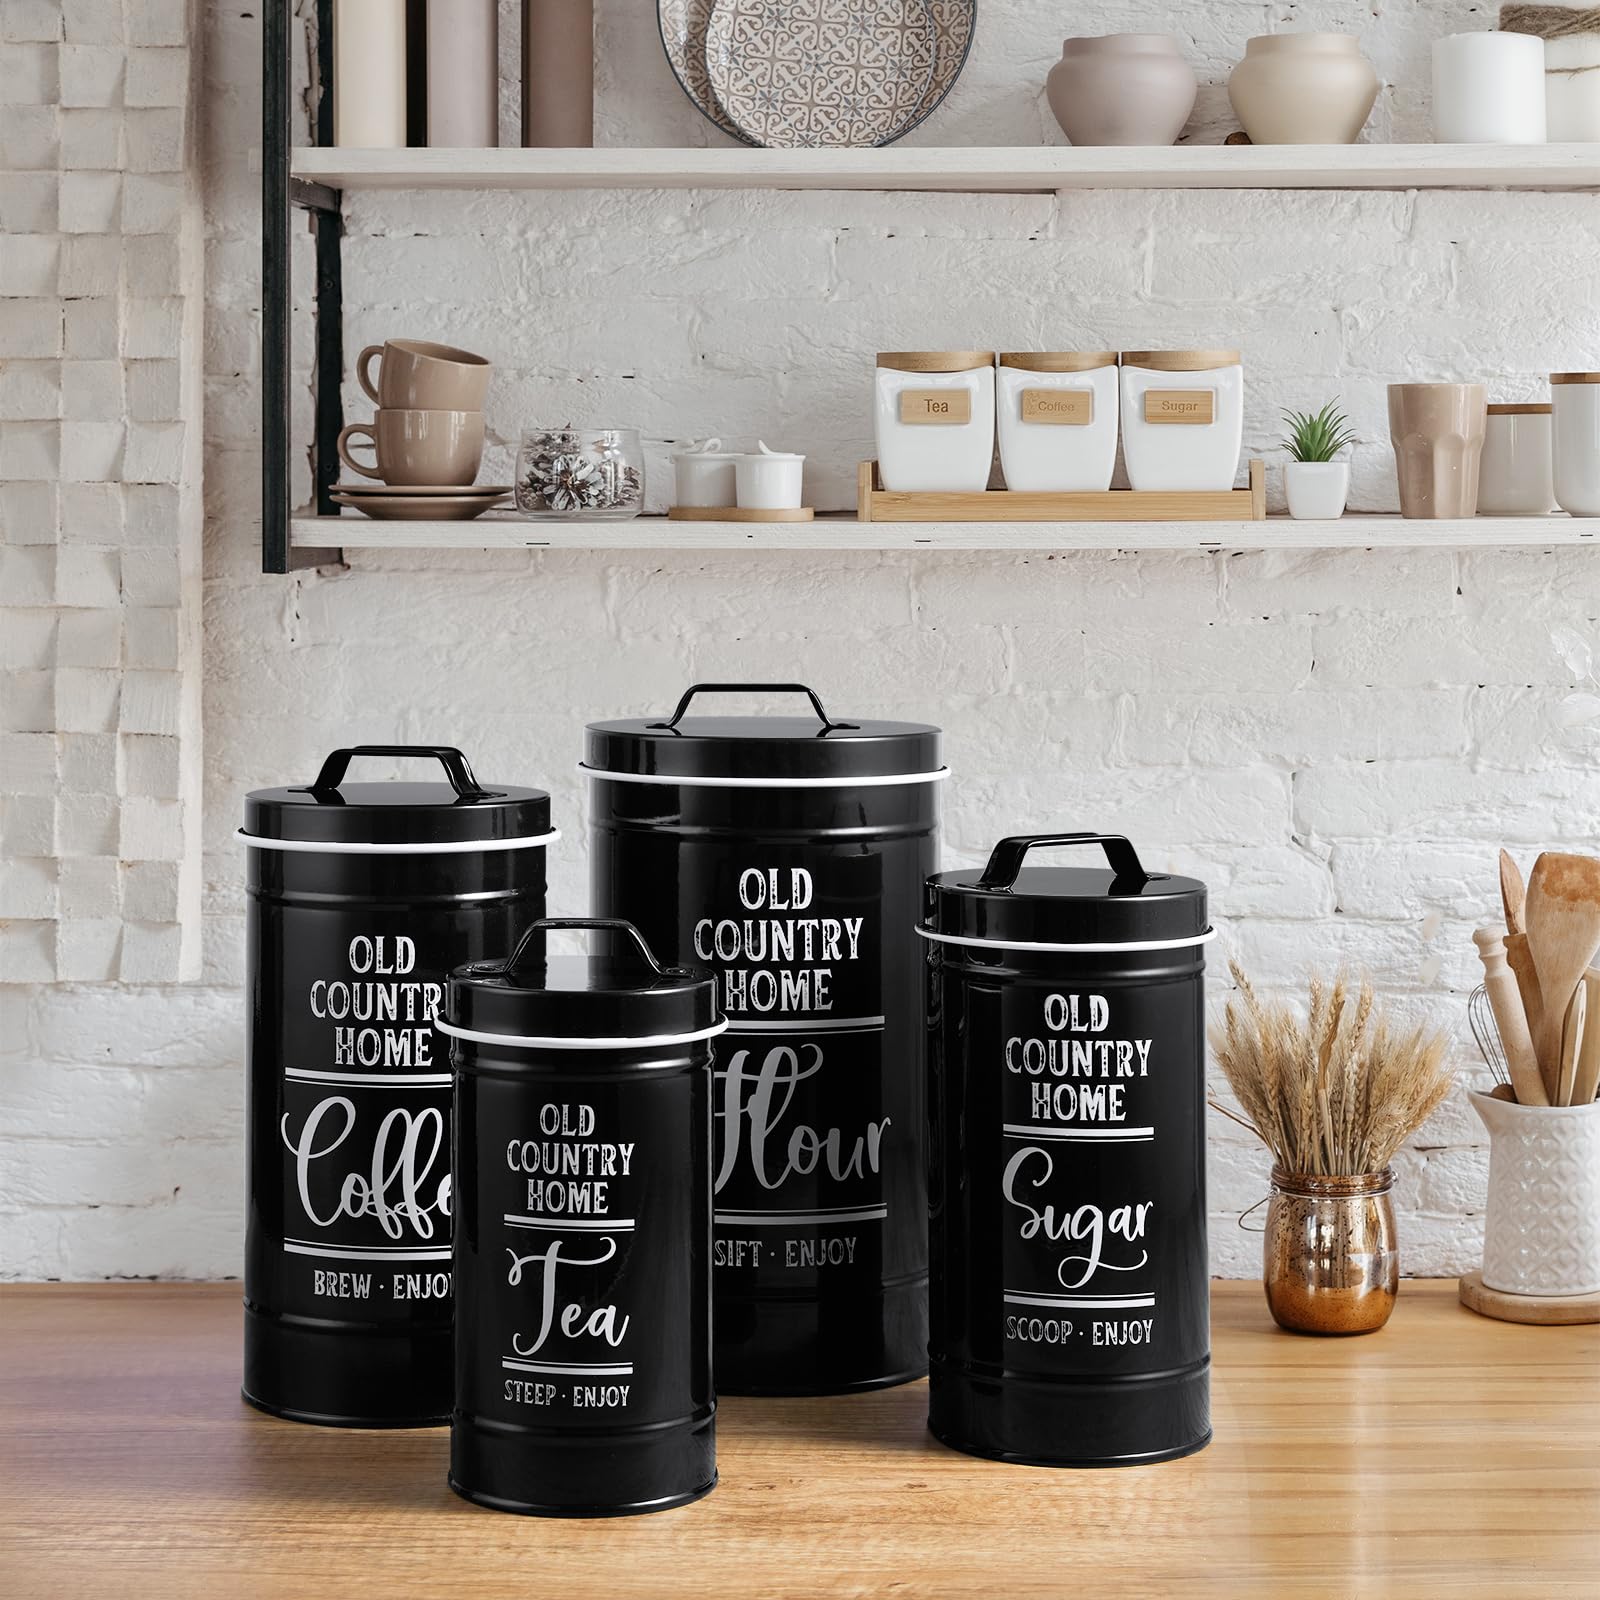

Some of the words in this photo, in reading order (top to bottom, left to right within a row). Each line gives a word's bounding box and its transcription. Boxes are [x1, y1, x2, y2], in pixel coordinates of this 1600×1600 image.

[924, 398, 949, 413] Tea
[1038, 401, 1075, 412] Coffee
[1161, 400, 1199, 414] Sugar
[739, 868, 813, 910] OLD
[349, 936, 415, 974] OLD
[694, 918, 864, 961] COUNTRY
[310, 980, 448, 1021] COUNTR
[724, 969, 833, 1011] HOME
[1044, 994, 1109, 1032] OLD
[335, 1027, 433, 1066] HOME
[1005, 1037, 1152, 1077] COUNTRY
[540, 1104, 595, 1136] OLD
[1032, 1082, 1126, 1121] HOME
[507, 1140, 635, 1176] COUNTRY
[527, 1179, 608, 1213] HOME
[1002, 1147, 1154, 1289] Sugar
[714, 1239, 763, 1267] SIFT
[785, 1237, 857, 1267] ENJOY
[314, 1270, 372, 1298] BREW
[393, 1273, 451, 1299] ENJO
[506, 1237, 630, 1356] Tea
[1006, 1316, 1073, 1344] SCOOP
[1093, 1319, 1153, 1346] ENJOY
[504, 1380, 556, 1406] STEEP
[573, 1386, 630, 1407] ENJOY
